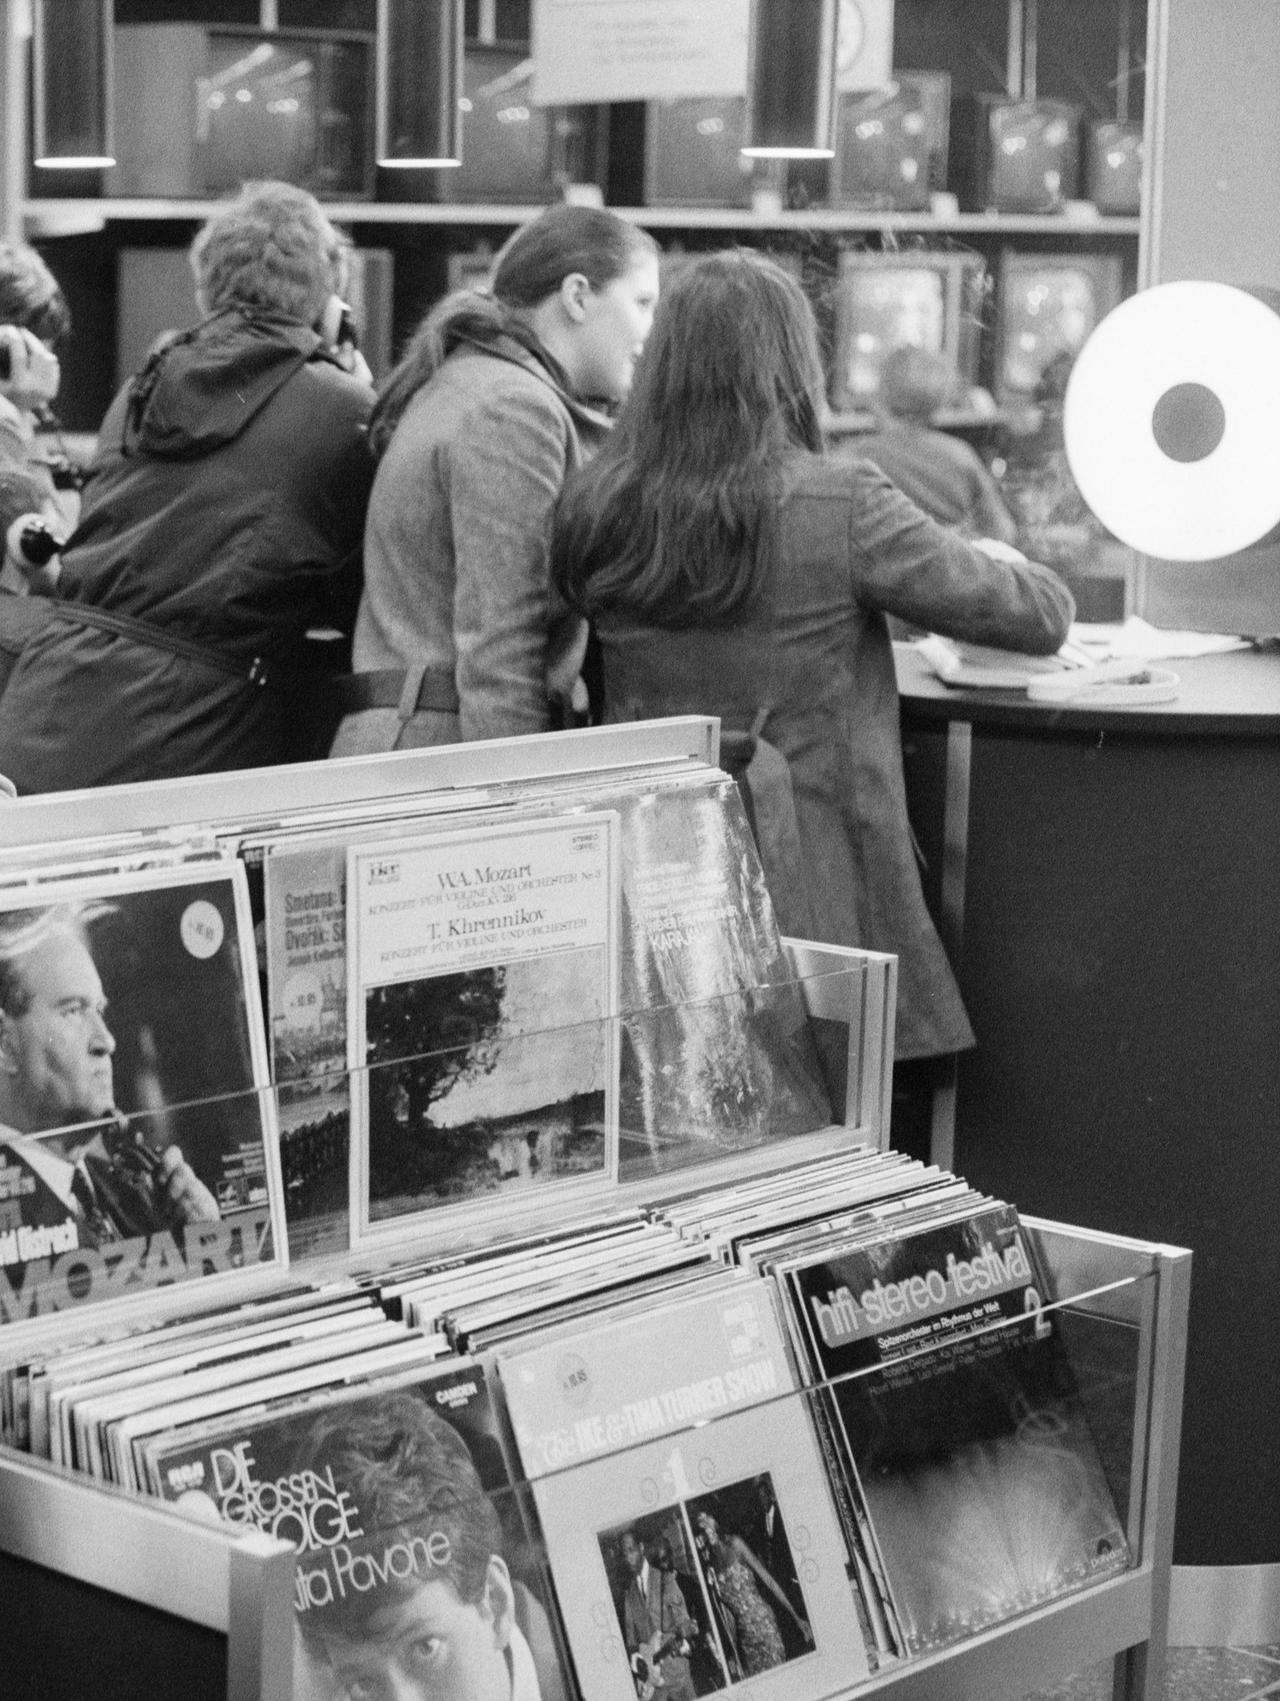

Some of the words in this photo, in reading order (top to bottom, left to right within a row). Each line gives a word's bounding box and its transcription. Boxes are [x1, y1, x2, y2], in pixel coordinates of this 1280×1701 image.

[444, 886, 489, 904] VIOLINE
[491, 881, 516, 896] UND
[517, 873, 578, 892] ORCHESTER
[475, 863, 532, 886] Mozart
[427, 922, 442, 941] T.
[448, 907, 547, 937] Khrennikov
[456, 932, 499, 950] VIOLINE
[501, 927, 525, 942] UND
[525, 918, 588, 937] ORCHESTER
[877, 1324, 933, 1350] Spitzenorchester
[940, 1311, 973, 1330] Rhythmus
[972, 1306, 984, 1318] der
[983, 1300, 1000, 1314] Welt
[574, 1415, 608, 1453] IKE
[622, 1396, 666, 1437] TINA
[659, 1376, 729, 1424] TURNER
[723, 1359, 778, 1404] SHOW
[210, 1440, 261, 1497] DIE
[222, 1464, 338, 1525] GROSSEN
[331, 1530, 452, 1599] Pavone
